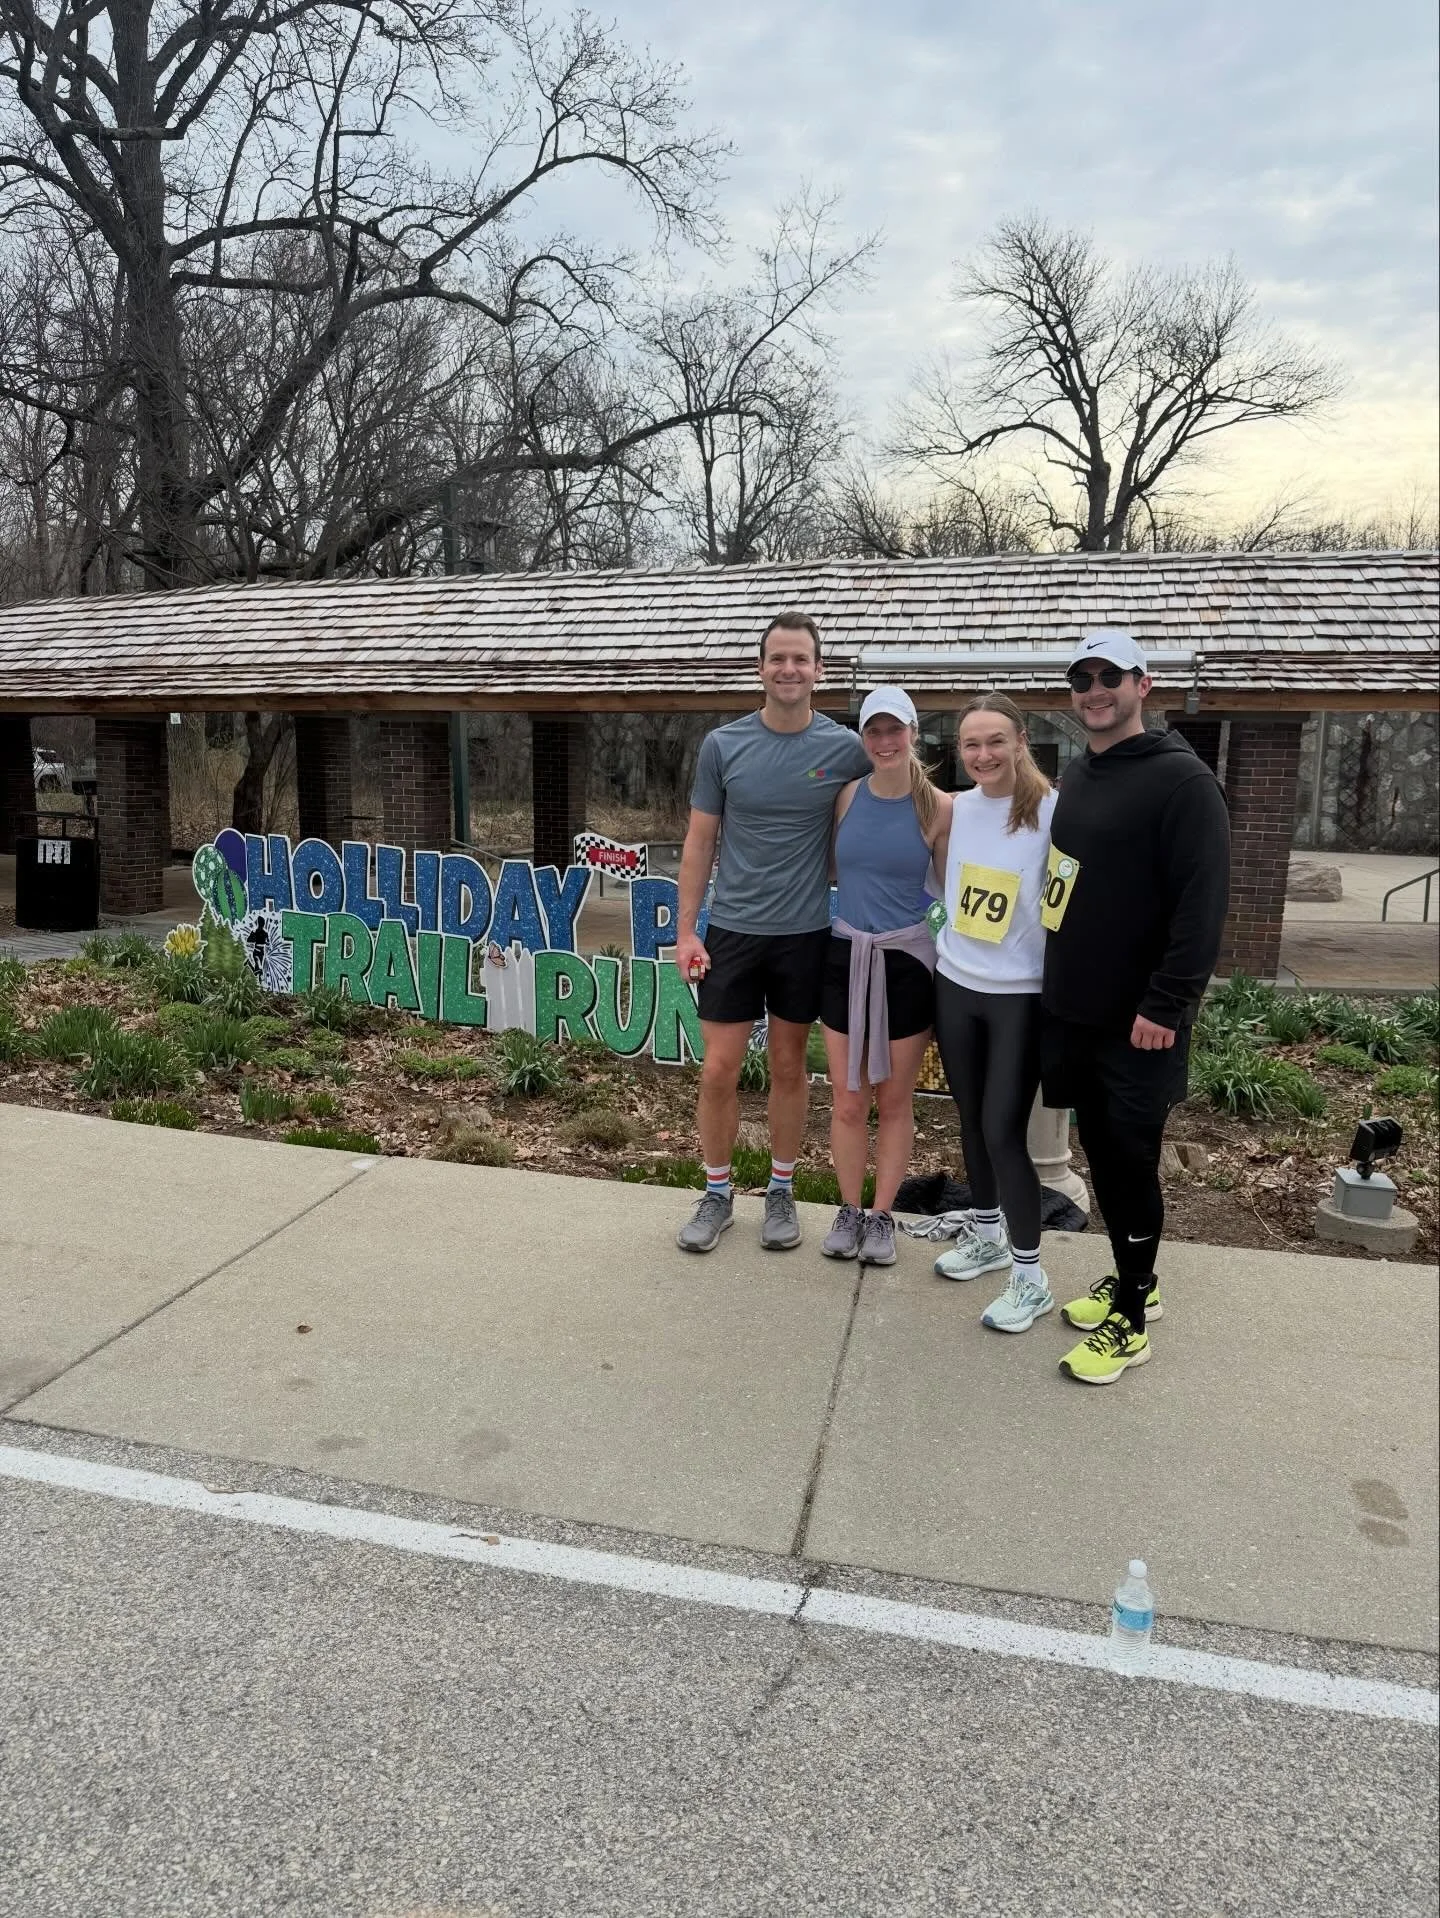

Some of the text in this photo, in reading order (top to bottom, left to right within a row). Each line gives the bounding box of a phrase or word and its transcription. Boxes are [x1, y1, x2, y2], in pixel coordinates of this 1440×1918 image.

[245, 833, 592, 952] HOLLIDAY
[598, 851, 627, 863] FINISH
[960, 885, 1008, 923] 479
[282, 911, 705, 1065] TRAIL RUN
